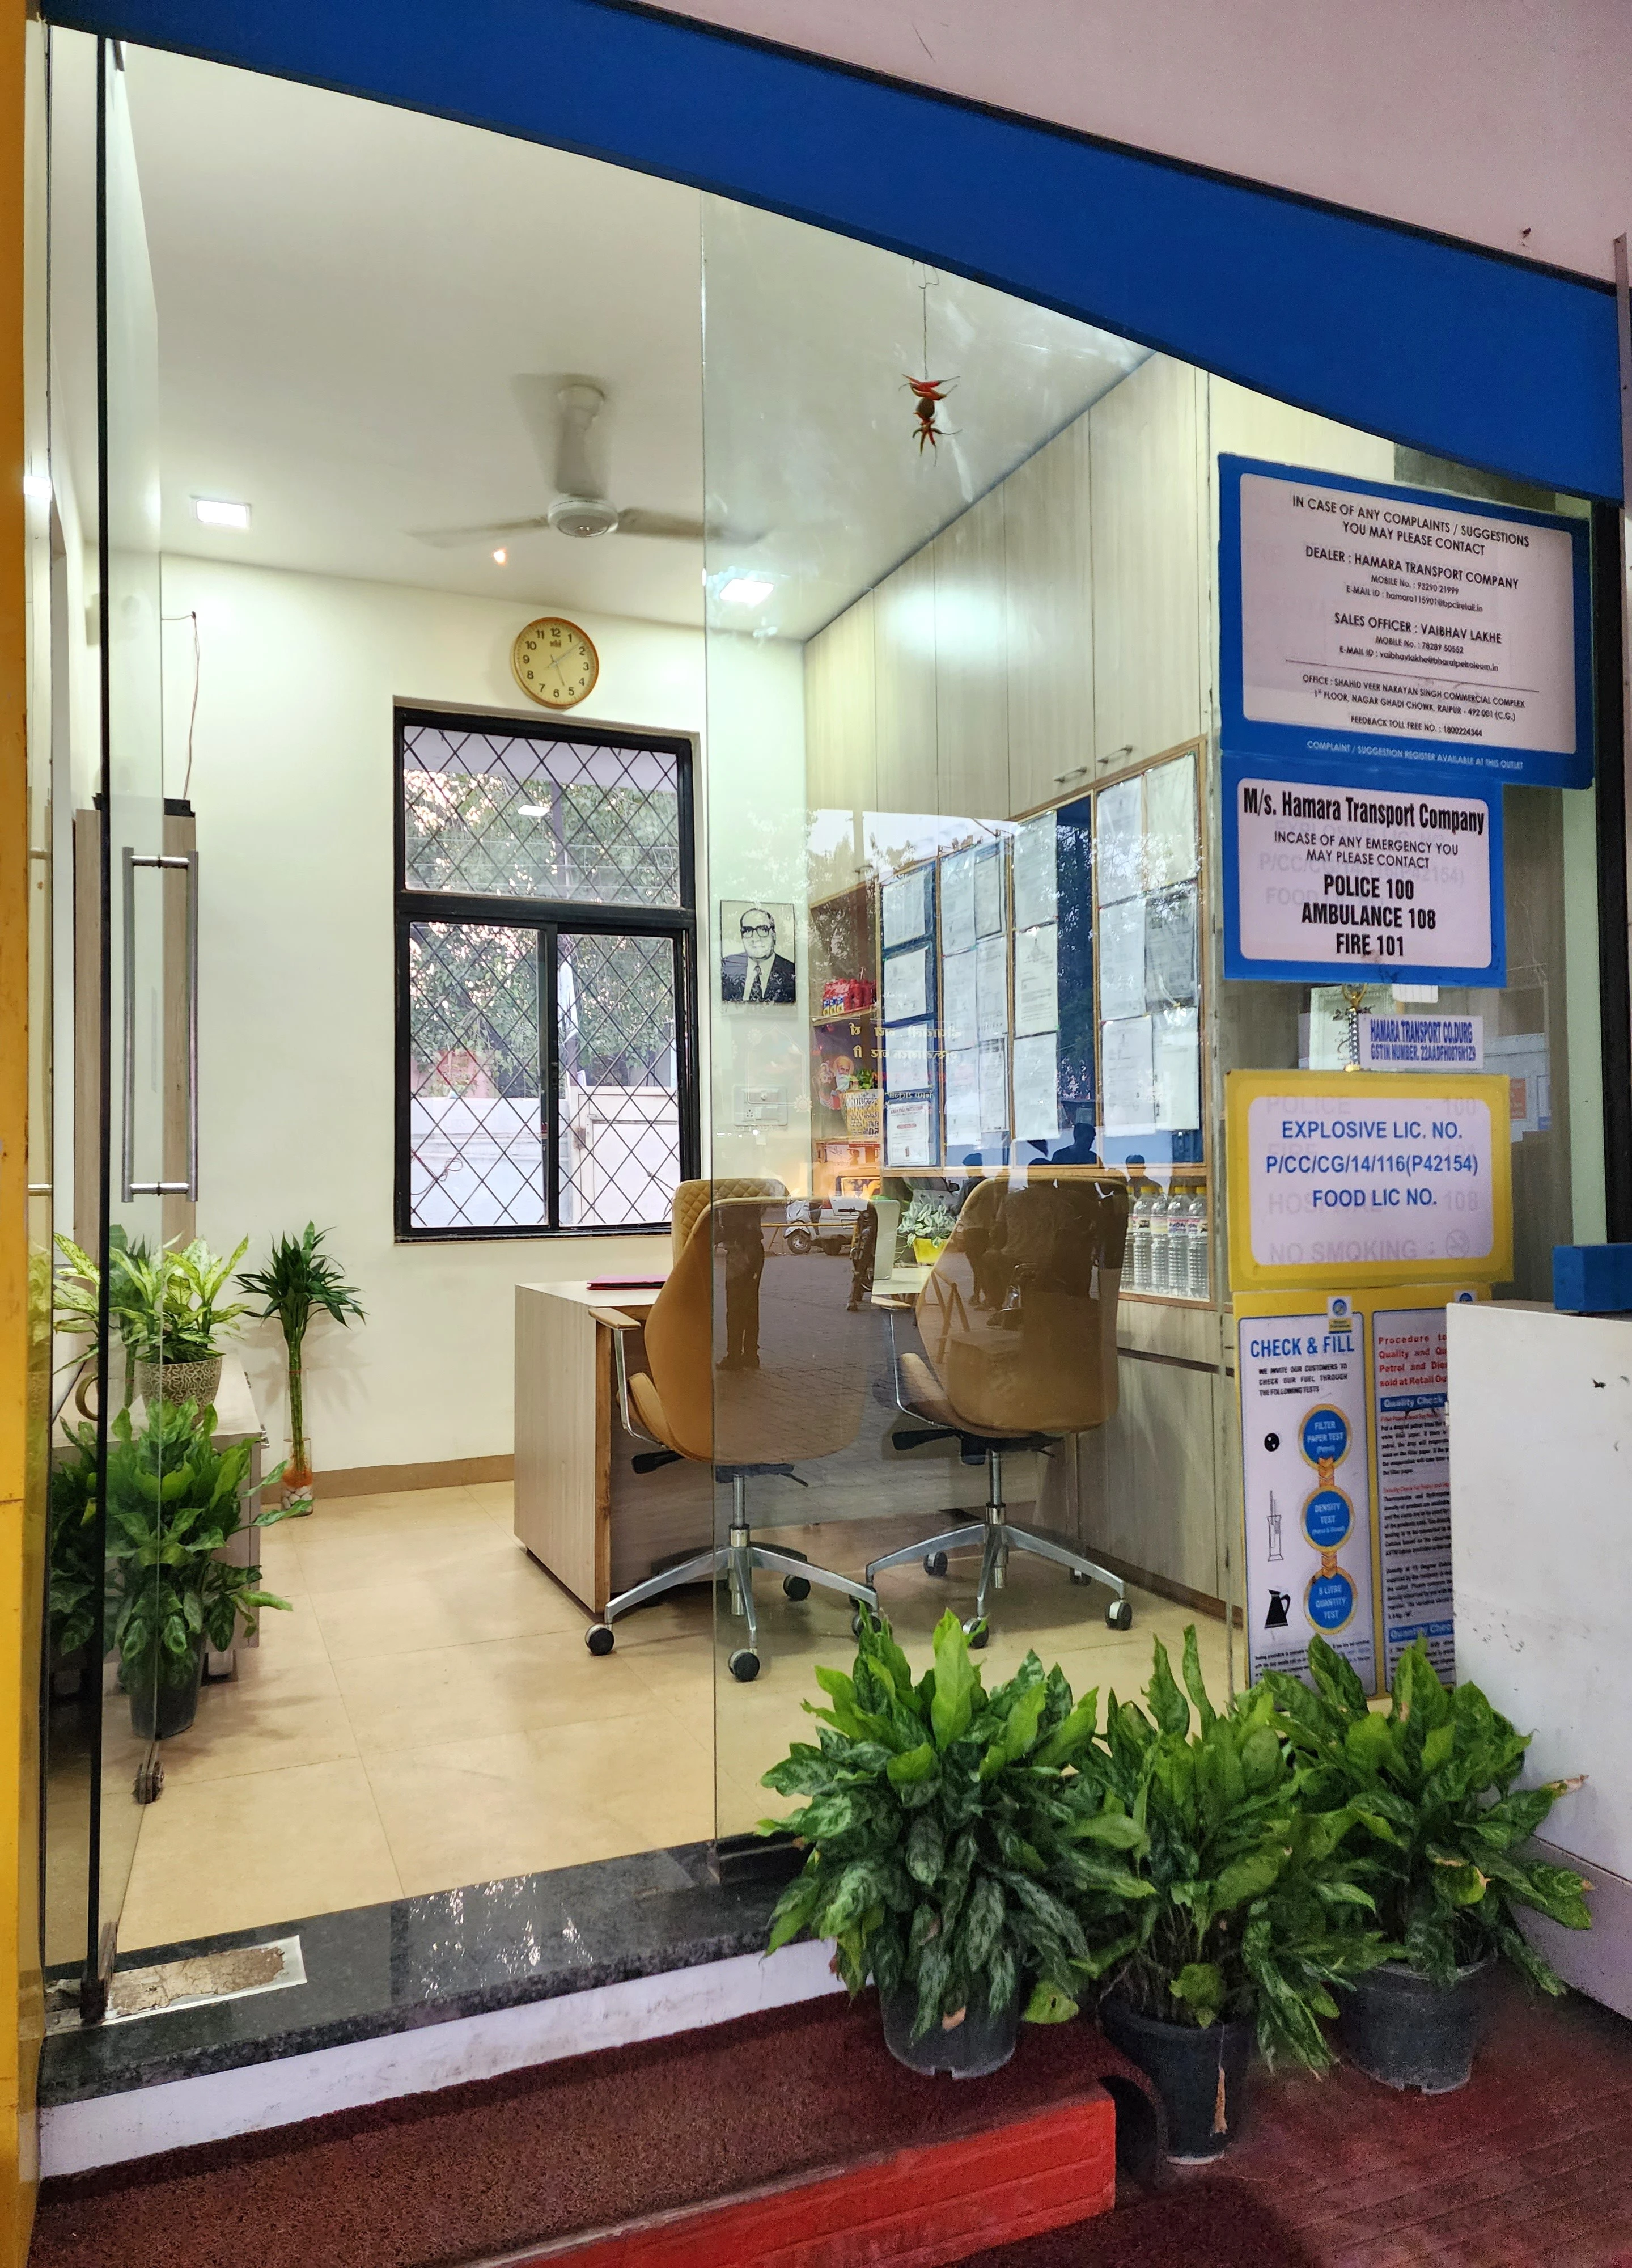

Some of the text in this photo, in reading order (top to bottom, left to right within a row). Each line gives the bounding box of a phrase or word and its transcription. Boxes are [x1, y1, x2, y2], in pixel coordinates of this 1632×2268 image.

[1292, 495, 1304, 507] IN
[1308, 498, 1336, 513] CASE
[1339, 504, 1354, 516] OF
[1358, 508, 1380, 521] ANY
[1384, 511, 1450, 534] COMPLAINTS
[1461, 526, 1529, 547] SUGGESTIONS
[1343, 522, 1485, 555] YOU MAY PLEASE CONTACT
[1305, 545, 1519, 589] DEALER HAMARA TRANSPORT COMPANY
[1346, 585, 1371, 596] E-MAIL
[1371, 575, 1398, 586] MOBILE
[1417, 582, 1438, 591] 93290
[1439, 585, 1459, 595] 21999
[536, 629, 544, 639] 11
[550, 628, 561, 637] 12
[567, 633, 572, 642] 1
[1334, 612, 1502, 644] SALES OFFICER VAIBHAV LAKHE
[525, 641, 536, 650] 10
[1375, 636, 1402, 646] MOBILE
[523, 655, 529, 663] 9
[1339, 646, 1364, 656] E-MAIL
[539, 683, 545, 692] 7
[1303, 674, 1525, 708] OFFICE SHAHID VEER NARAYAN SINGH COMMERCIAL COMPLEX
[1352, 695, 1378, 705] NAGAR
[1380, 698, 1404, 708] GHADI
[1438, 705, 1461, 714] RAIPUR
[1351, 716, 1388, 726] FEEDBACK
[1389, 719, 1405, 729] TOLL
[1407, 721, 1422, 730] FREE
[1307, 741, 1350, 752] COMPLAINT
[1358, 746, 1402, 758] SUGGESTION
[1405, 751, 1435, 760] REGISTER
[1437, 754, 1474, 765] AVAILABLE
[1501, 760, 1523, 769] OUTLET
[1244, 788, 1484, 835] M/s. Hamara Transport Company
[1274, 831, 1459, 855] INCASE OF ANY EMERGENCY YOU
[1306, 849, 1429, 869] MAY PLEASE CONTACT
[1324, 874, 1380, 898] POLICE
[1387, 879, 1414, 899] 100
[1302, 903, 1436, 929] AMBULANCE 108
[1336, 933, 1404, 956] FIRE 101
[1371, 1019, 1399, 1041] HAMARA
[1401, 1020, 1441, 1043] TRANSPORT
[1282, 1121, 1463, 1139] EXPLOSIVE LIC. NO.
[1266, 1155, 1478, 1176] P/CC/CG/14/116(P42154)
[1312, 1188, 1437, 1207] FOOD LIC NO.
[1251, 1335, 1354, 1358] CHECK & FILL
[1379, 1335, 1429, 1344] Procedure
[1380, 1364, 1405, 1372] Petrol
[1409, 1376, 1433, 1385] Retail
